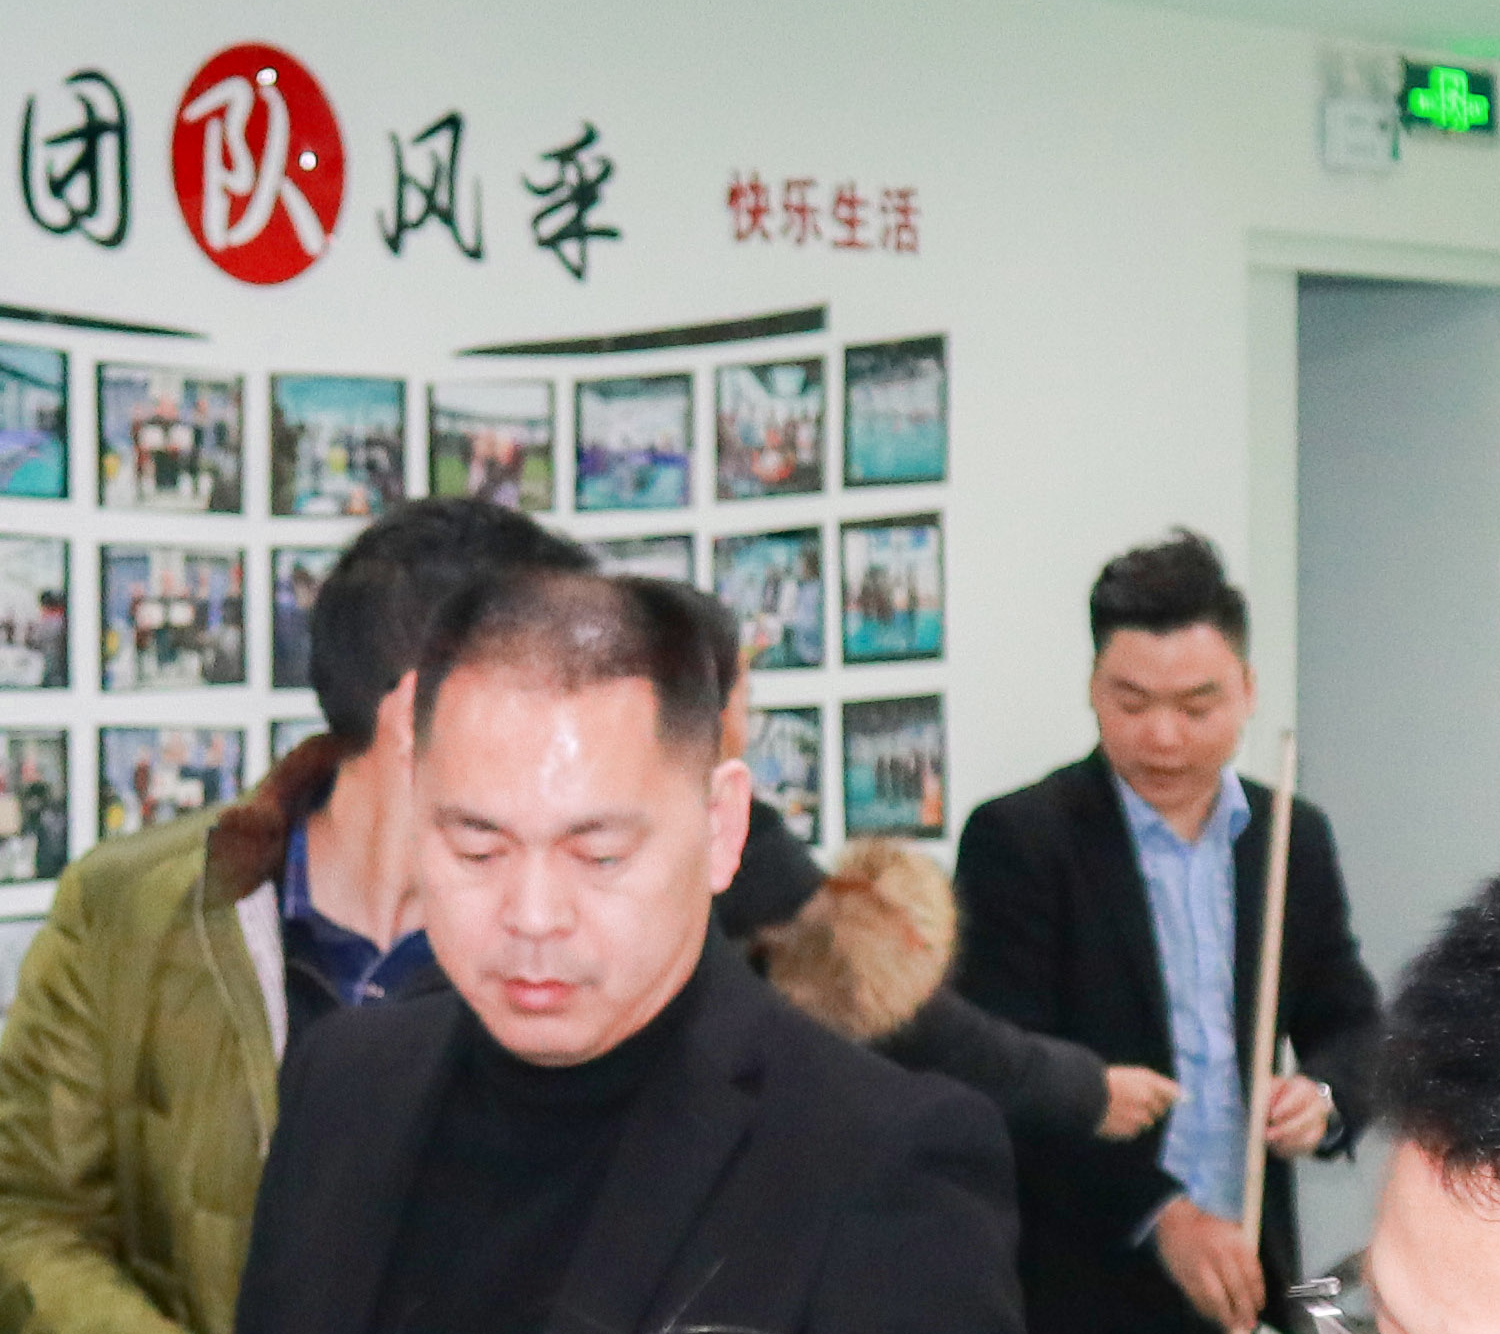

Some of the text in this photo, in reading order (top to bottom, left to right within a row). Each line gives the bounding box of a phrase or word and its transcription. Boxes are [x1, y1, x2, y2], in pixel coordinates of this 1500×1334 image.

[20, 69, 624, 281] 团队风采
[724, 170, 922, 255] 快乐生活
